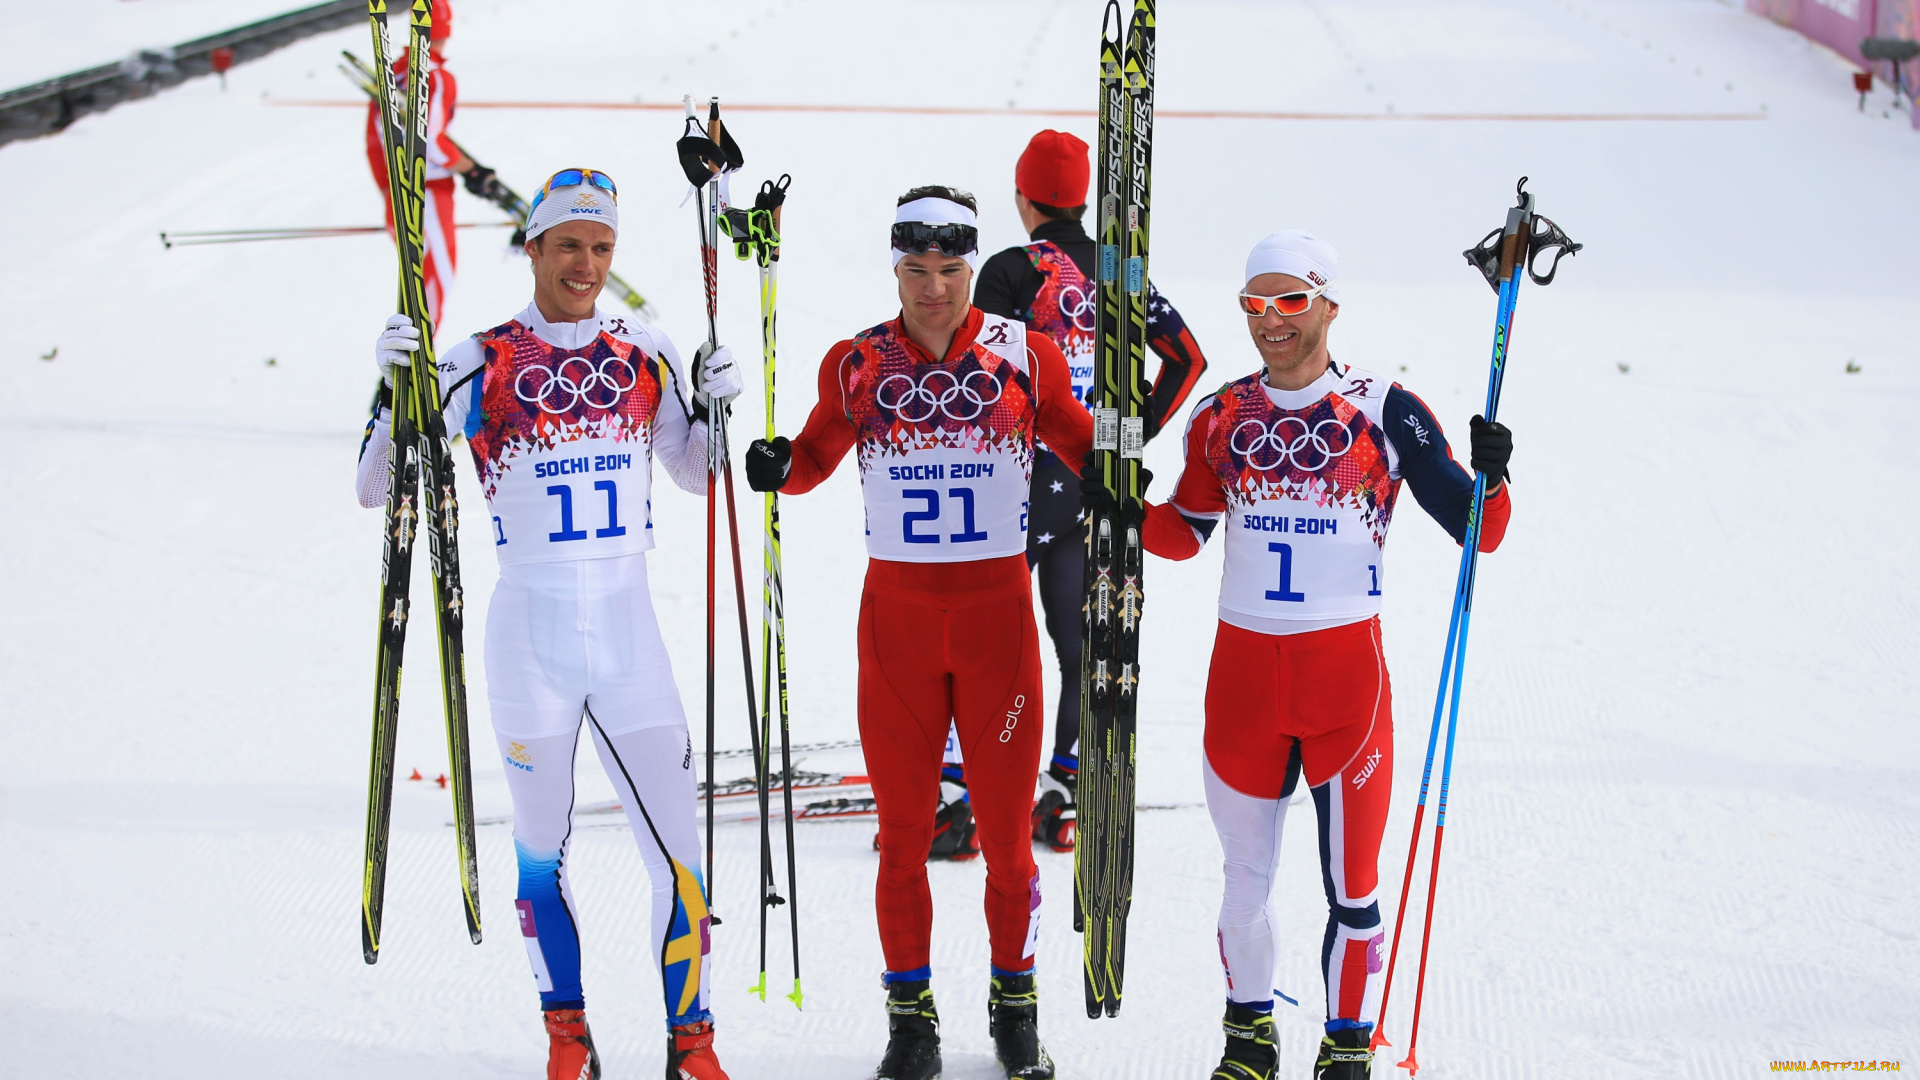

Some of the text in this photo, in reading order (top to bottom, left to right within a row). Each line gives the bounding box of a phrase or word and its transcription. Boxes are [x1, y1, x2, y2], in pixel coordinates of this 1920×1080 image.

[380, 21, 402, 131] FISCHER
[416, 35, 431, 143] FISCHER
[1108, 87, 1123, 200] FISCHER
[1133, 97, 1146, 210] FISCHER
[1306, 270, 1328, 287] Swi
[534, 453, 632, 479] SOCHI 2014
[755, 442, 775, 458] odlo
[888, 463, 994, 481] SOCHI 2014
[381, 438, 397, 587] FISCHER
[418, 431, 442, 579] FISCHER
[546, 479, 626, 543] 11
[902, 487, 988, 544] 21
[1243, 514, 1337, 535] SOCHI 2014
[1265, 542, 1305, 602] 1
[1368, 564, 1382, 596] 1
[999, 695, 1025, 743] odlo
[506, 757, 534, 773] SWE
